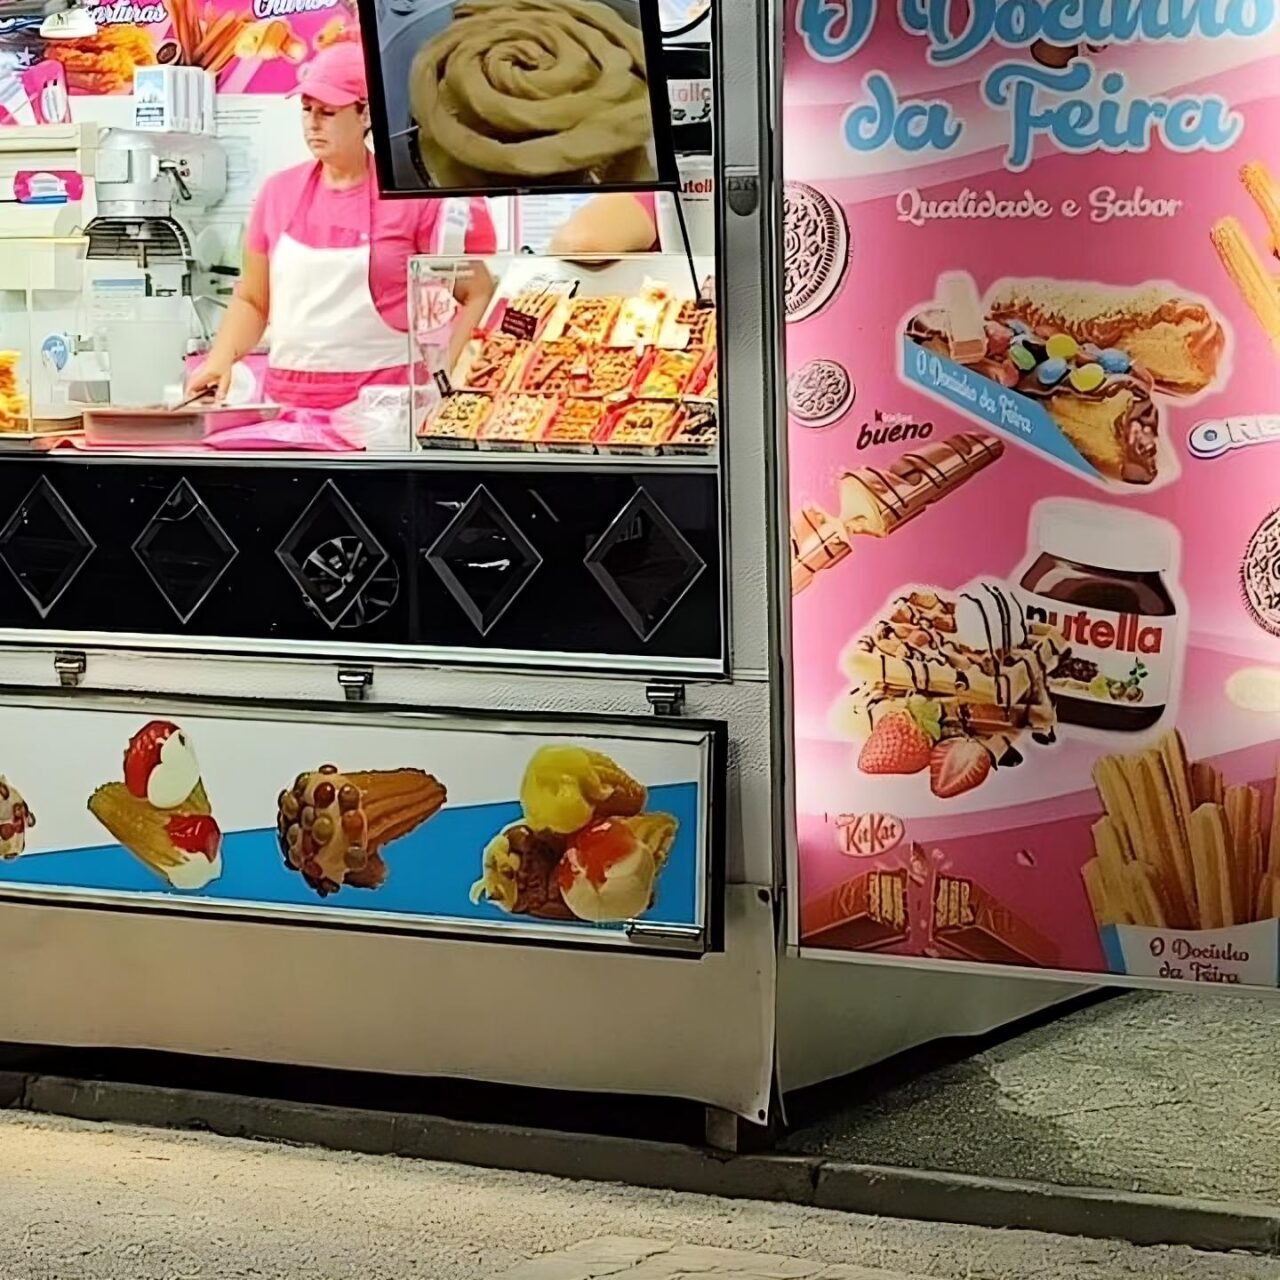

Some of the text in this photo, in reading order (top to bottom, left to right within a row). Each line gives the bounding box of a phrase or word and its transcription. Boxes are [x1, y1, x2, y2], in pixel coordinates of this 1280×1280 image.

[844, 57, 1243, 173] da Feira
[680, 179, 713, 193] utell
[896, 186, 1182, 226] Qualidade e Sabor
[856, 422, 933, 450] bueno
[1026, 603, 1163, 655] nutella
[846, 813, 896, 854] KitKat
[1149, 937, 1249, 962] O Docinho
[1159, 961, 1240, 984] da Feira
